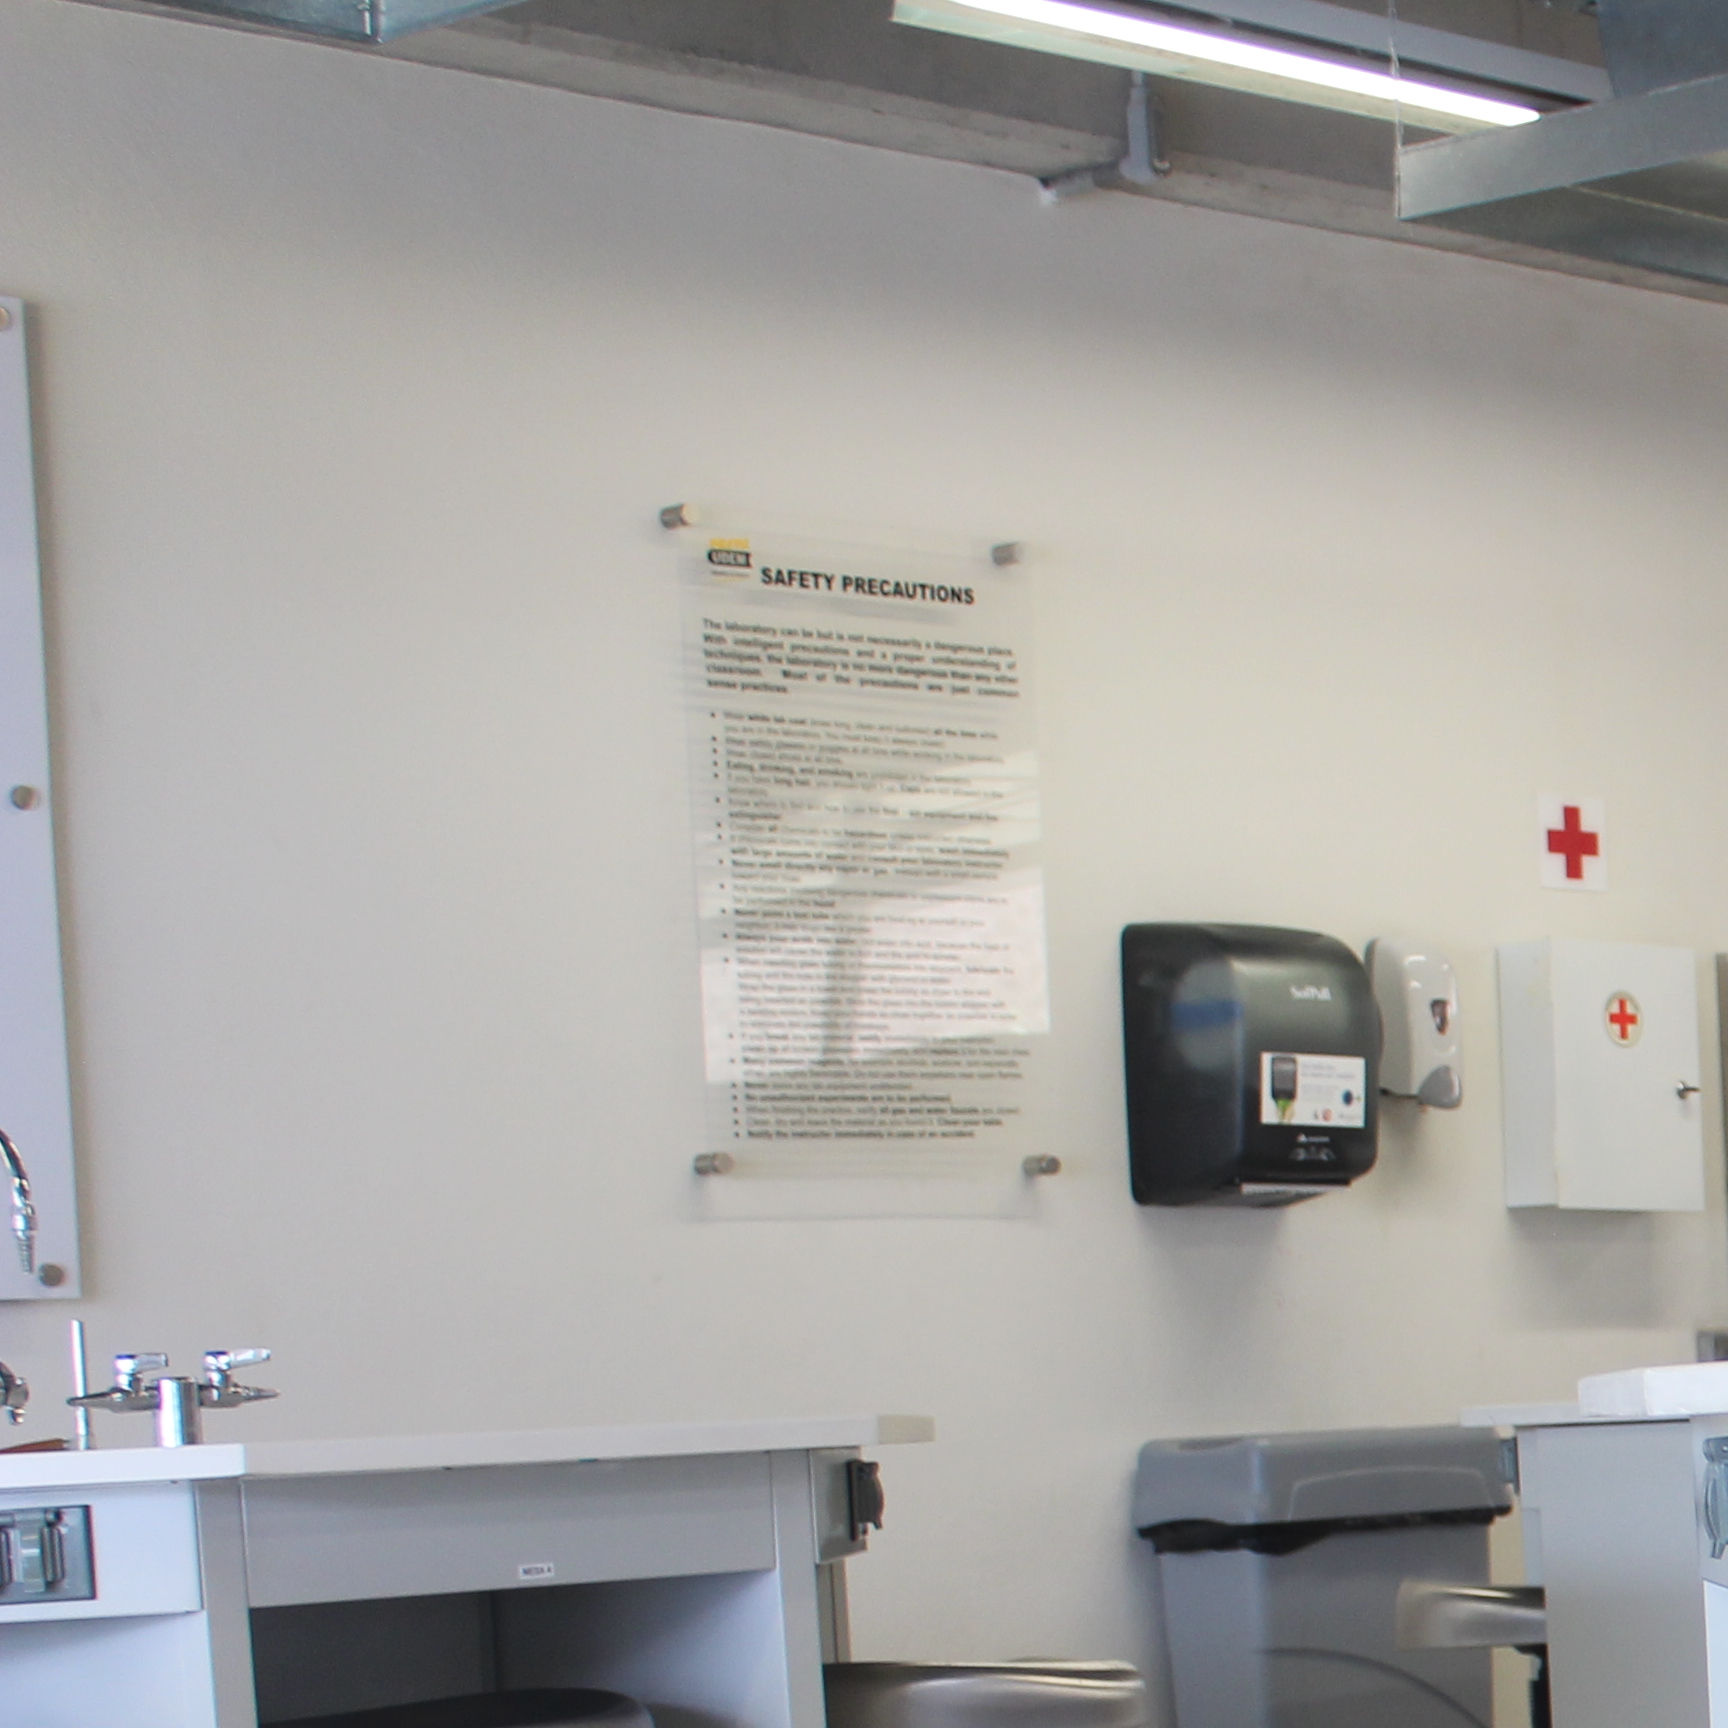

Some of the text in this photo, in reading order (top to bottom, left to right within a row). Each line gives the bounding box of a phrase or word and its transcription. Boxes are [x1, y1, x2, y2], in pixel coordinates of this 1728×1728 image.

[761, 566, 975, 605] SAFETY PRECAUTIONS
[703, 617, 721, 629] The
[724, 619, 777, 637] laboratory
[867, 633, 921, 651] necessarily
[934, 639, 984, 657] dangerous
[703, 631, 727, 645] With
[733, 634, 784, 652] intelligent
[790, 640, 849, 658] precautions
[857, 646, 874, 658] and
[893, 651, 925, 664] proper
[932, 652, 1000, 671] understanding
